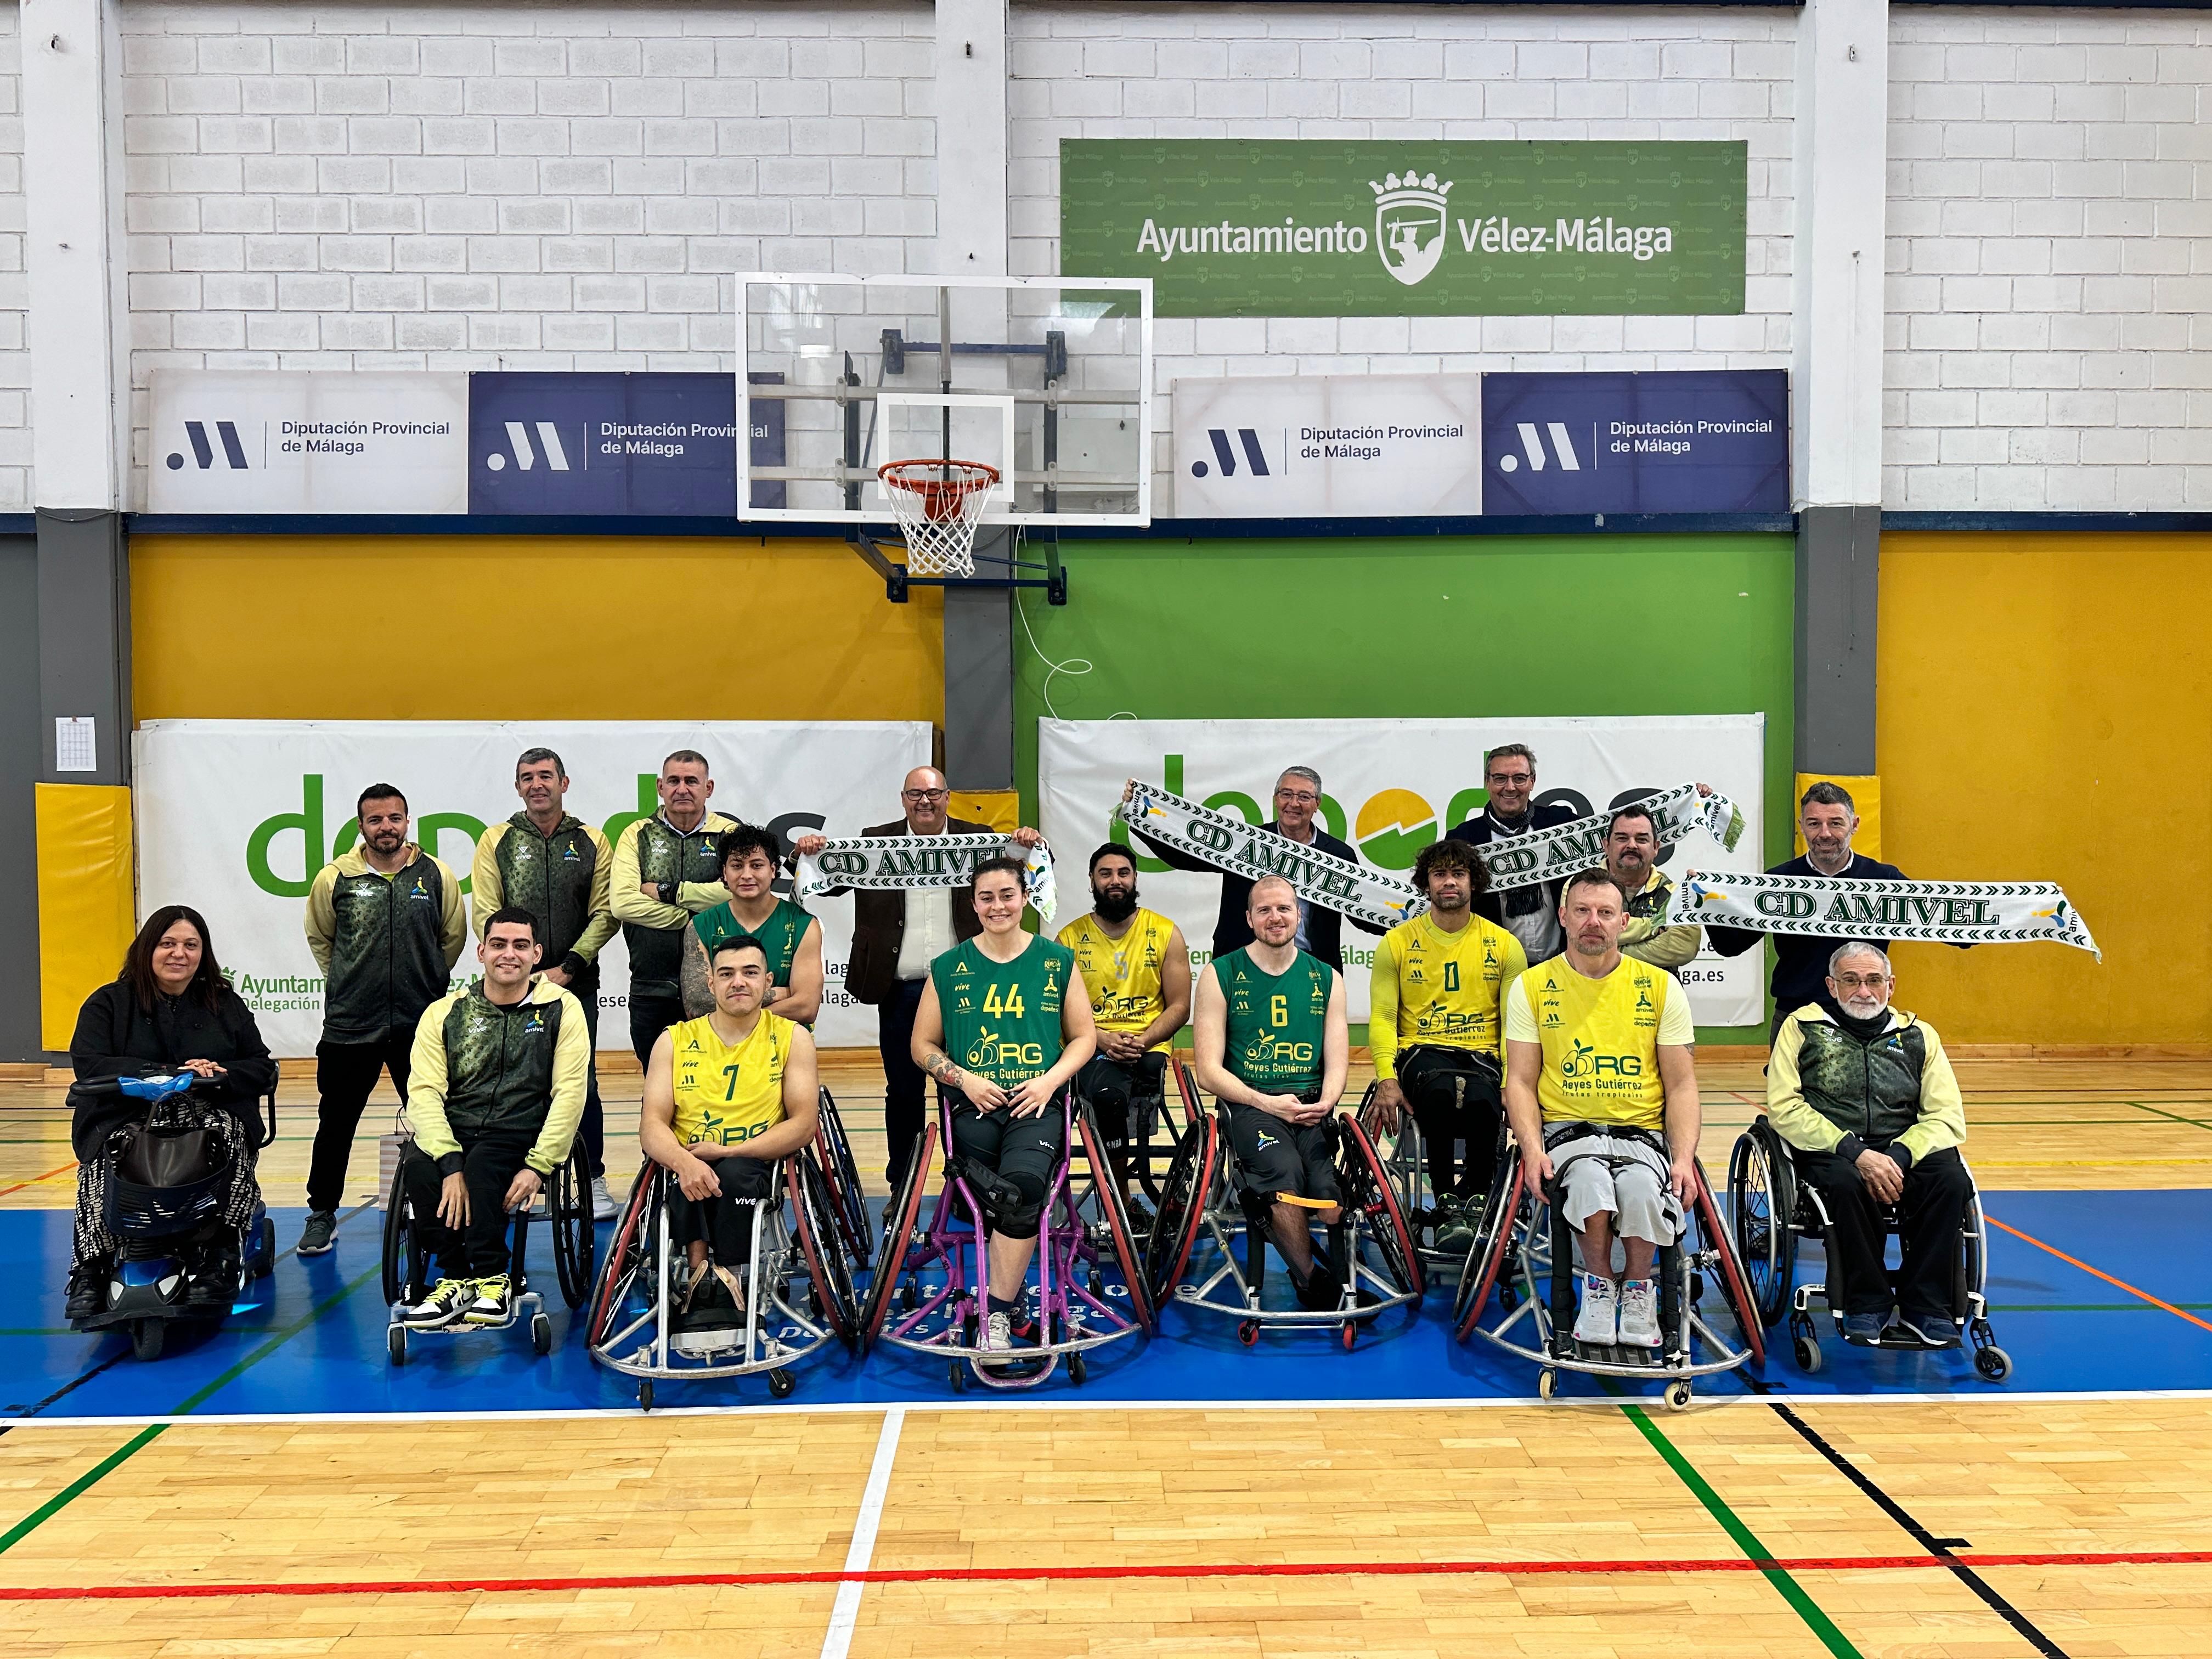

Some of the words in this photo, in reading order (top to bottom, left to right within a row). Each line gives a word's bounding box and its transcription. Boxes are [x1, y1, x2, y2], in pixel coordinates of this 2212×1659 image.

[1136, 217, 1367, 261] Ayuntamiento
[1457, 216, 1672, 261] Vélez-Málaga
[281, 421, 368, 438] Diputación
[373, 421, 449, 435] Provincial
[601, 421, 687, 439] Diputación
[691, 424, 768, 437] Proviial
[1301, 426, 1384, 443] Diputación
[1388, 424, 1463, 439] Provincial
[1610, 420, 1692, 437] Diputación
[1697, 420, 1772, 433] Provincial
[281, 439, 301, 453] de
[306, 438, 364, 456] Málaga
[601, 440, 620, 455] de
[624, 439, 683, 458] Málaga
[1301, 445, 1320, 458] de
[1324, 443, 1380, 461] Málaga
[1610, 438, 1629, 453] de
[1634, 438, 1690, 456] Málaga
[1132, 791, 1141, 817] amivel
[1709, 802, 1721, 830] amivel
[1488, 848, 1538, 876] CD
[1547, 808, 1679, 866] AMIL
[817, 852, 869, 874] CD
[1187, 819, 1233, 852] CD
[1234, 840, 1363, 902] AMIVEL
[1681, 882, 1692, 912] amivel
[1412, 899, 1426, 919] mivel
[1754, 891, 1816, 918] CD
[1826, 893, 2000, 926] AMIVEL
[2068, 909, 2078, 932] amiv
[1115, 952, 1128, 980] 5
[983, 984, 1025, 1019] 44
[1117, 996, 1149, 1011] RG
[1271, 995, 1288, 1027] 6
[999, 1043, 1042, 1064] RG
[1274, 1042, 1313, 1060] RG
[969, 1070, 996, 1079] eyes
[1244, 1061, 1269, 1073] Reyes
[1273, 1062, 1312, 1073] Gutiérrez
[1594, 1056, 1641, 1076] RG
[723, 1064, 739, 1101] 7
[1595, 1079, 1642, 1090] Gutiérrez
[1258, 1139, 1280, 1151] amivel
[735, 1197, 756, 1205] vive
